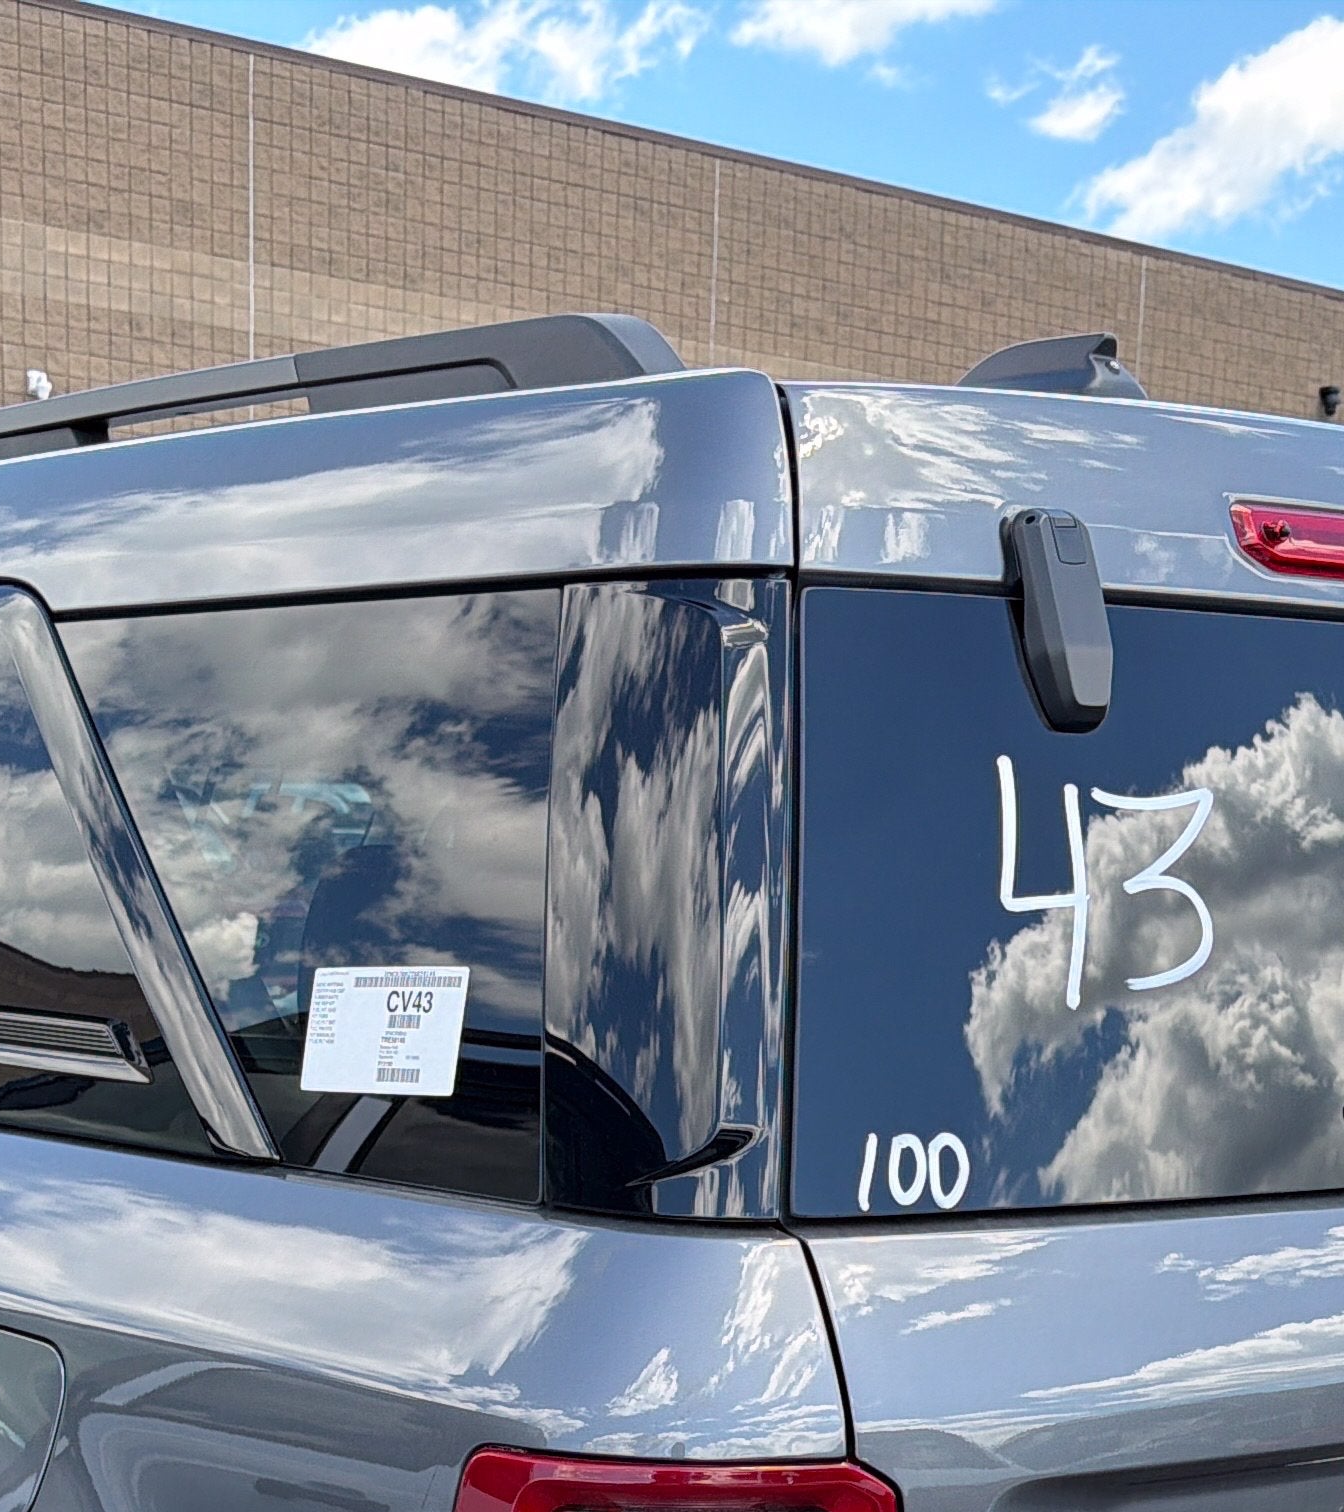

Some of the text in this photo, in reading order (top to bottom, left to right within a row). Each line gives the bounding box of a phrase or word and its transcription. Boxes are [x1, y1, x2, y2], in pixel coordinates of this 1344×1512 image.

[996, 754, 1214, 1011] 43
[386, 990, 434, 1014] CV43
[858, 1132, 970, 1212] 100
